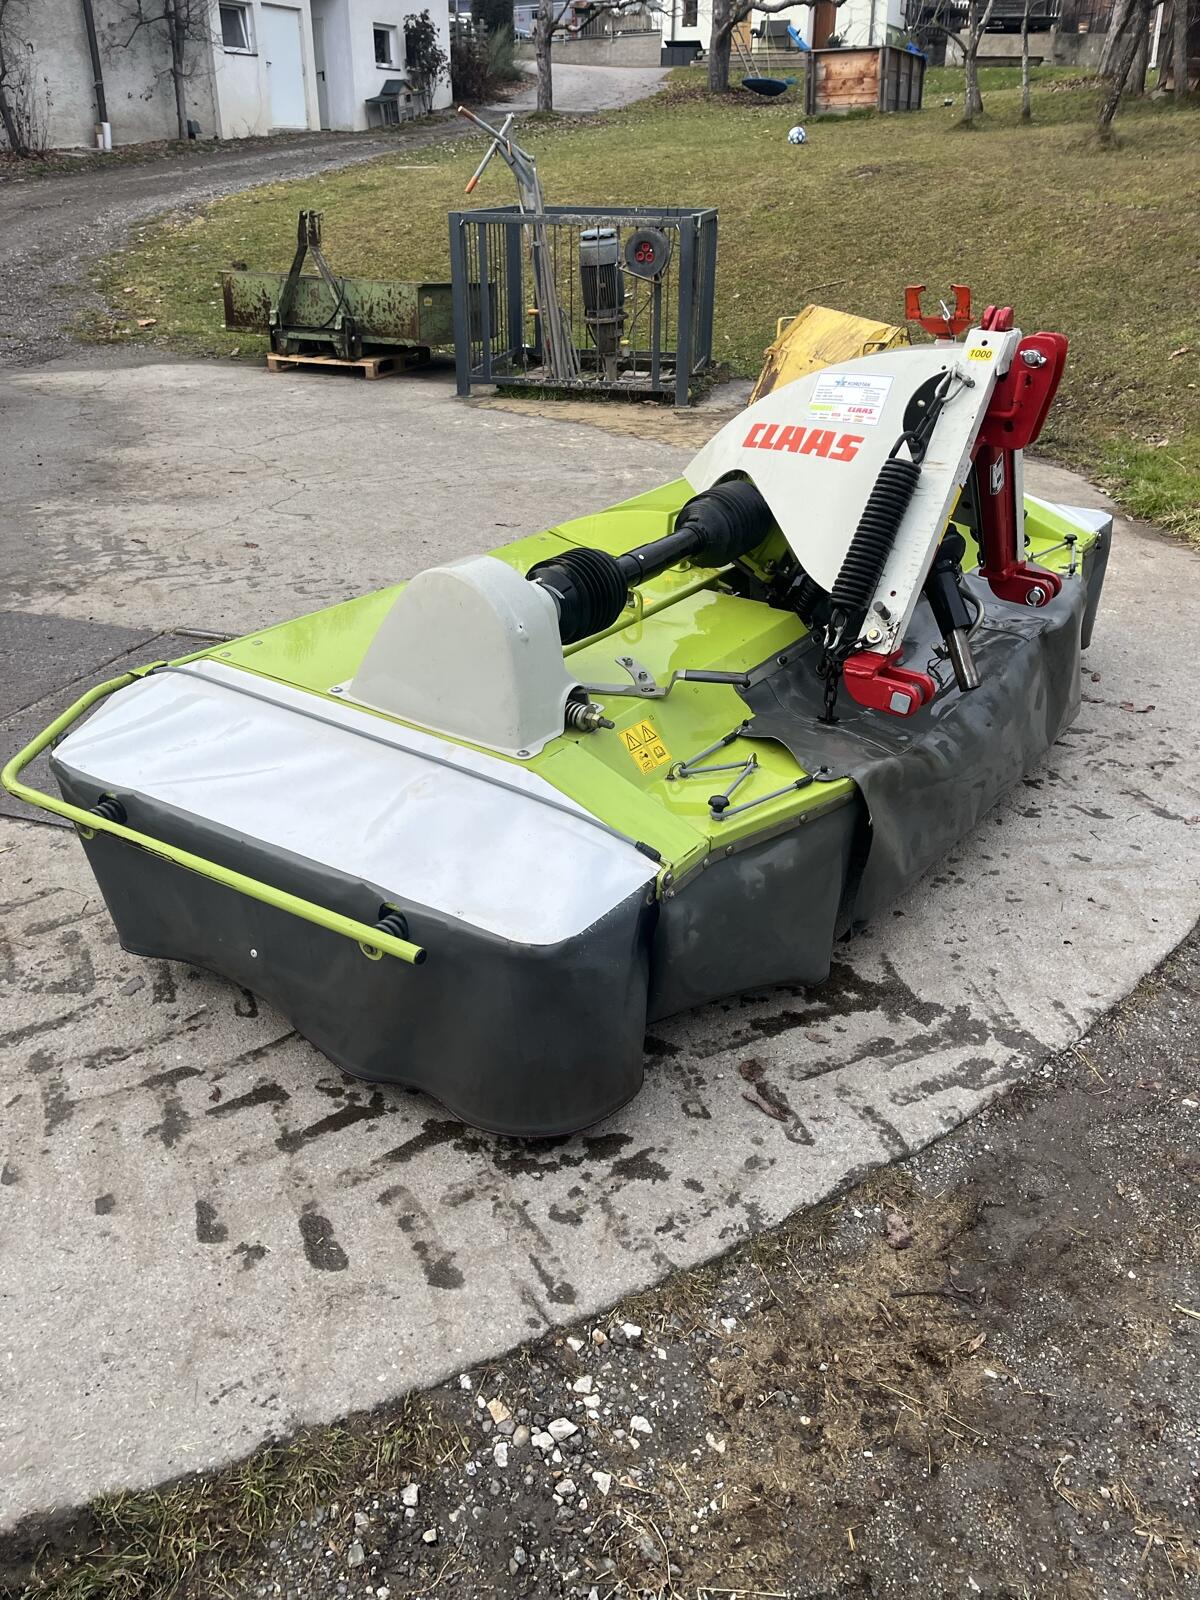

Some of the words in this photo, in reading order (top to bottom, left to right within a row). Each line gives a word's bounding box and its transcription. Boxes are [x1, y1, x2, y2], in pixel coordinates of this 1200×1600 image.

[970, 349, 992, 359] 1000
[847, 406, 874, 415] CLAAS
[742, 423, 865, 462] CLAAS
